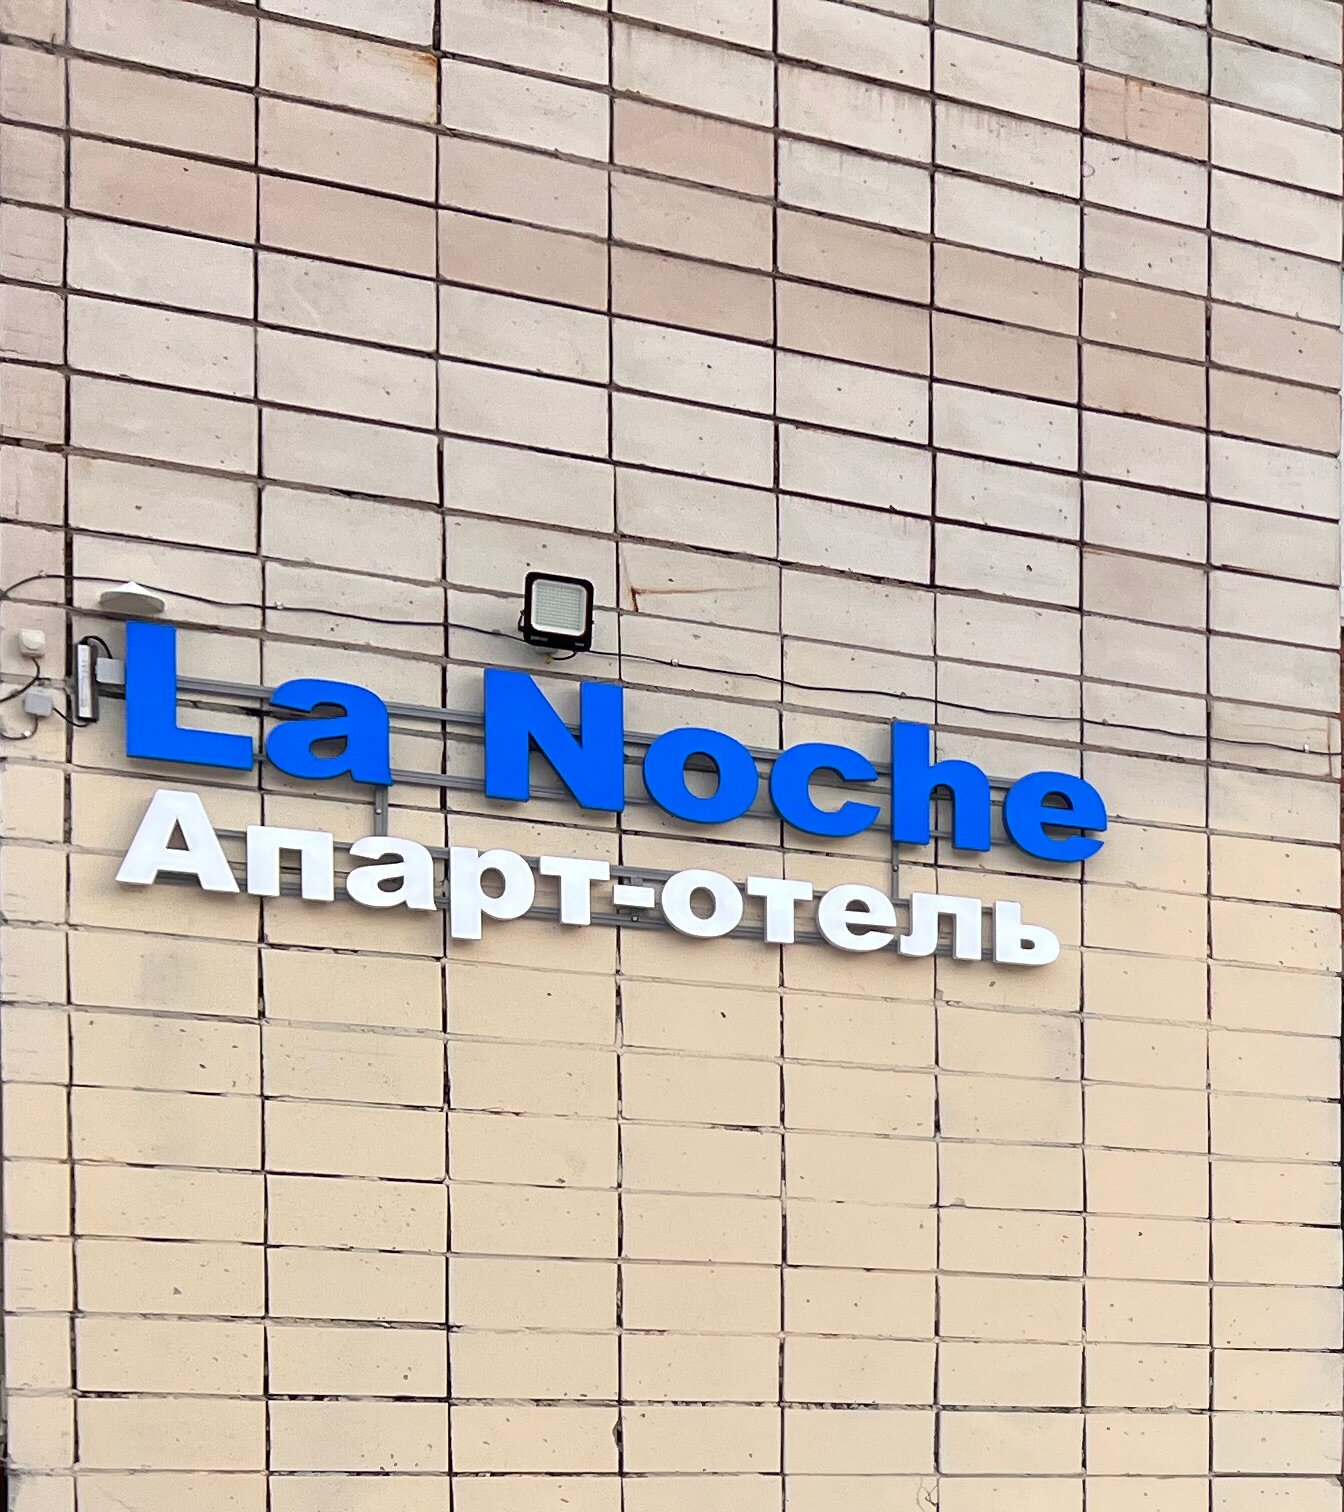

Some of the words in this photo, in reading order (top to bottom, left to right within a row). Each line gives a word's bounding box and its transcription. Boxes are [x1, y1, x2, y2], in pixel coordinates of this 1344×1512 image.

[124, 620, 394, 786] La
[483, 668, 1108, 863] Noche
[115, 788, 1061, 967] Апарт-отель
